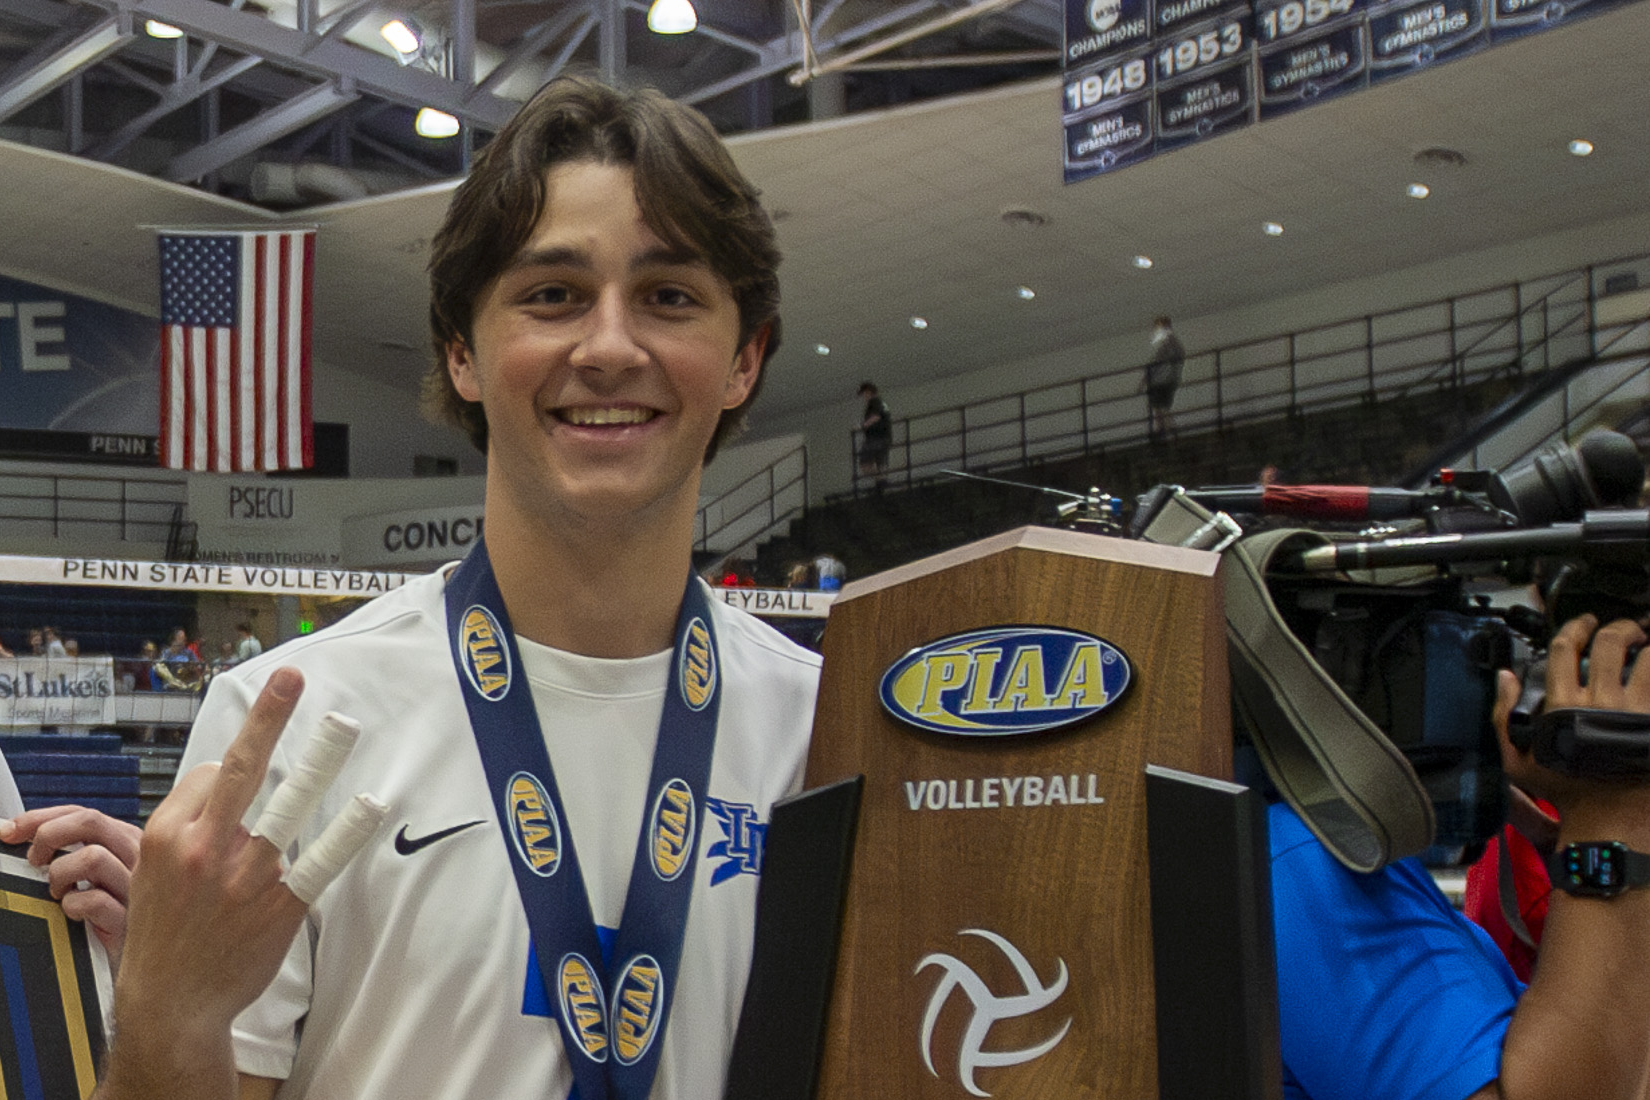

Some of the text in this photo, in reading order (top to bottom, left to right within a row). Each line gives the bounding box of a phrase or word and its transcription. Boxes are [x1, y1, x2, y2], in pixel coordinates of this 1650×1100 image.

[1069, 18, 1146, 59] CHAMPIONS
[1158, 21, 1243, 77] 1953
[1065, 58, 1147, 110] 1948
[91, 435, 147, 455] PENN
[229, 485, 295, 520] PSECU
[62, 559, 139, 583] PENN
[149, 562, 233, 586] STATE
[914, 642, 1109, 718] PIAA
[904, 773, 1105, 811] VOLLEYBALL
